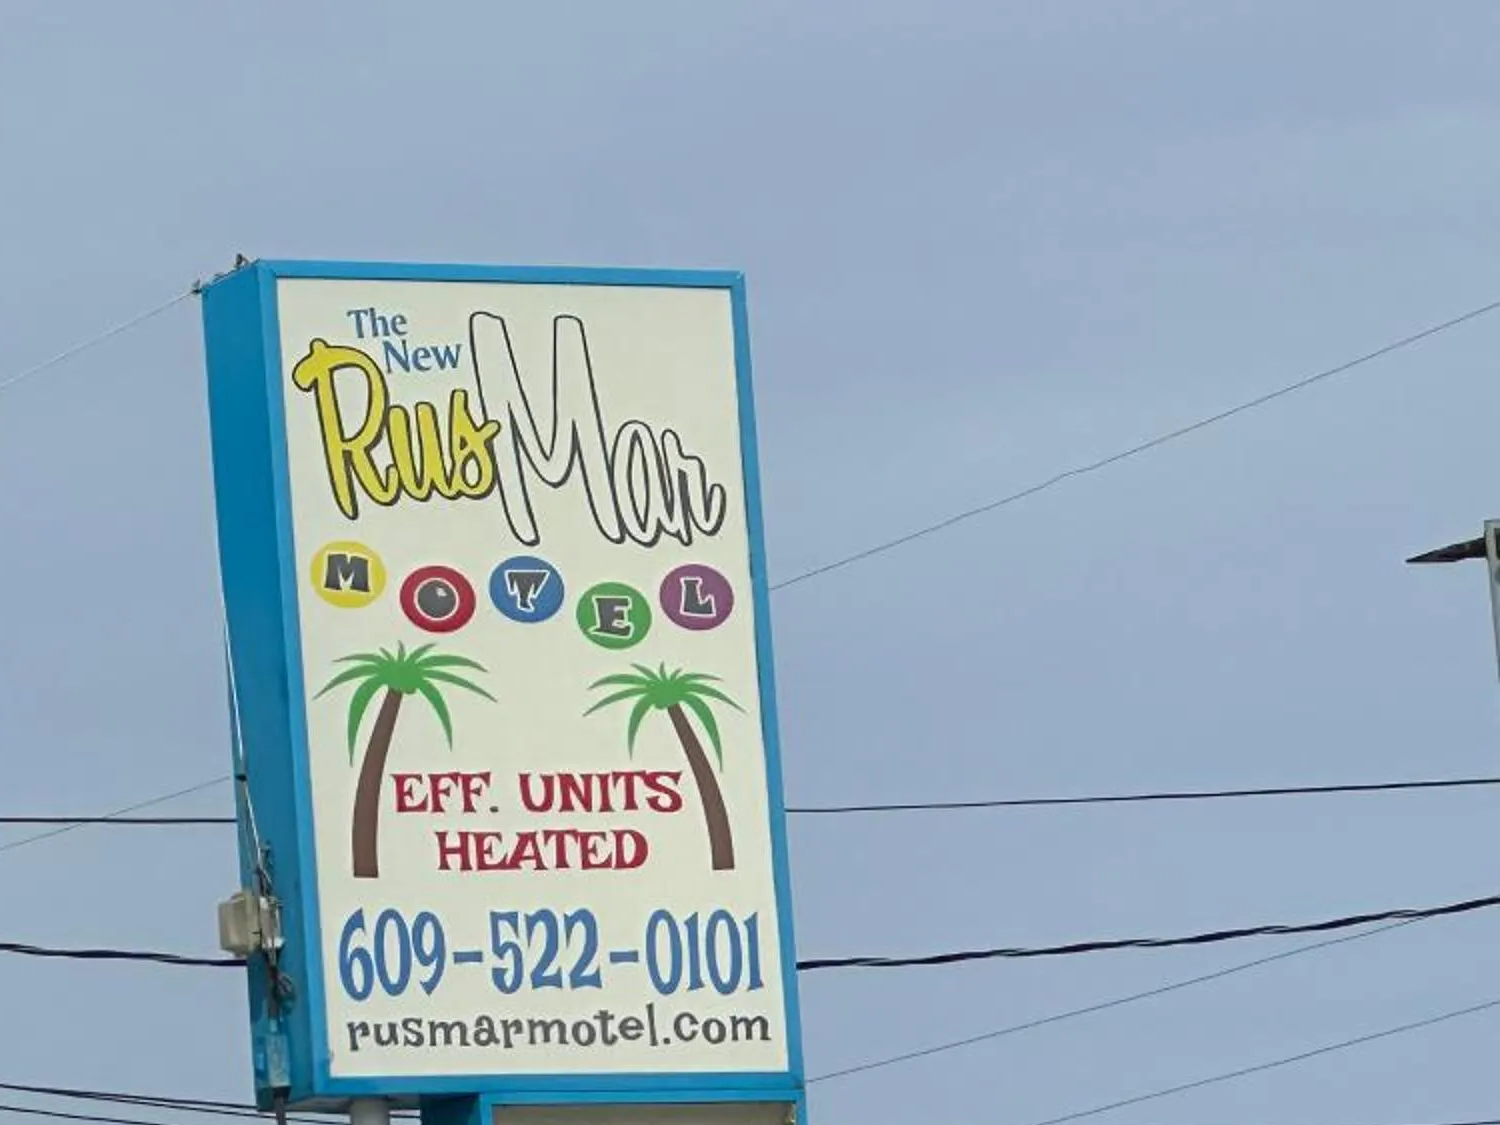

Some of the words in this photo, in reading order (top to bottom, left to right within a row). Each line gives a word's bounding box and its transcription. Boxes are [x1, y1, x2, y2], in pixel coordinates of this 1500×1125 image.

[348, 309, 407, 339] The
[384, 338, 462, 373] New
[292, 338, 501, 521] Rus
[469, 311, 726, 547] Mar
[322, 553, 717, 638] MOTEL
[392, 771, 499, 813] EFF.
[518, 771, 684, 813] UNITS
[435, 829, 648, 871] HEATED
[338, 907, 764, 1001] 609-522-0101
[347, 1004, 771, 1051] rusmarmotel.com
